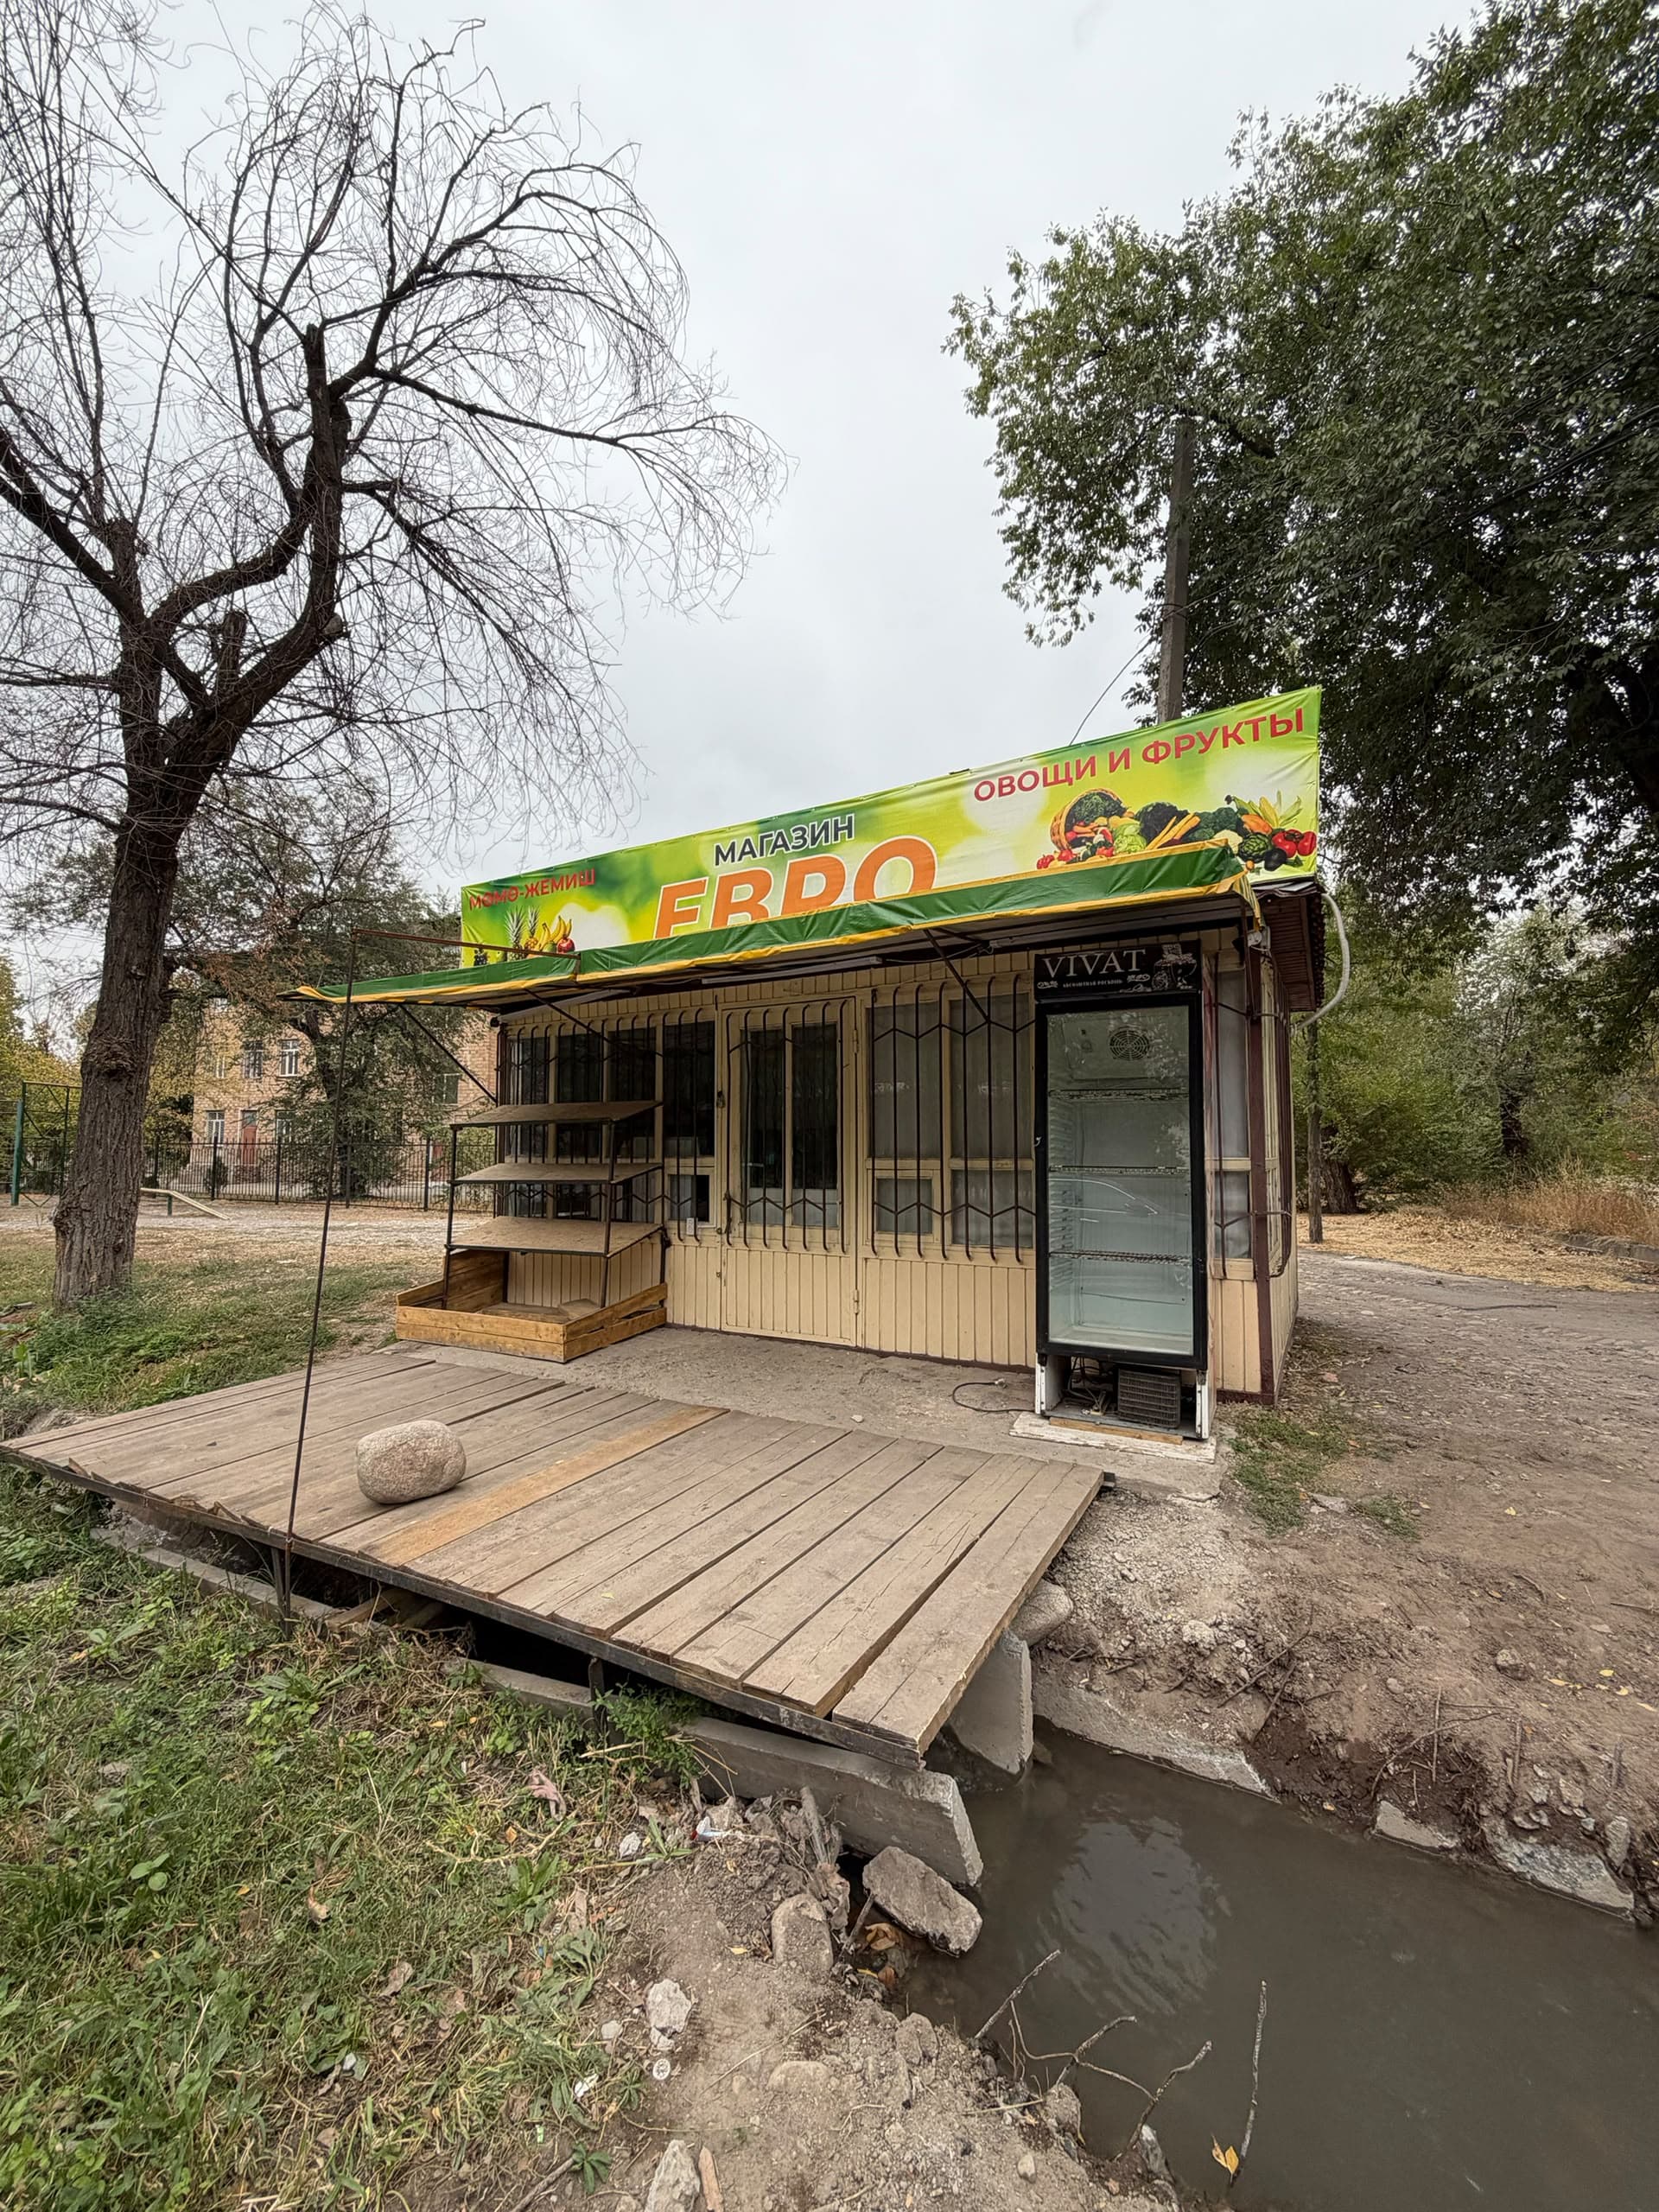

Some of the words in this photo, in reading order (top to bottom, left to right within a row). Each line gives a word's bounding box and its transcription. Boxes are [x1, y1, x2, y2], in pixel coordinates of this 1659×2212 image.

[974, 754, 1096, 802] ОВОЩИ
[1108, 747, 1131, 773] И
[1141, 708, 1304, 765] ФРУКТЫ
[714, 814, 855, 867] МАГАЗИН
[1042, 949, 1146, 978] VIVAT
